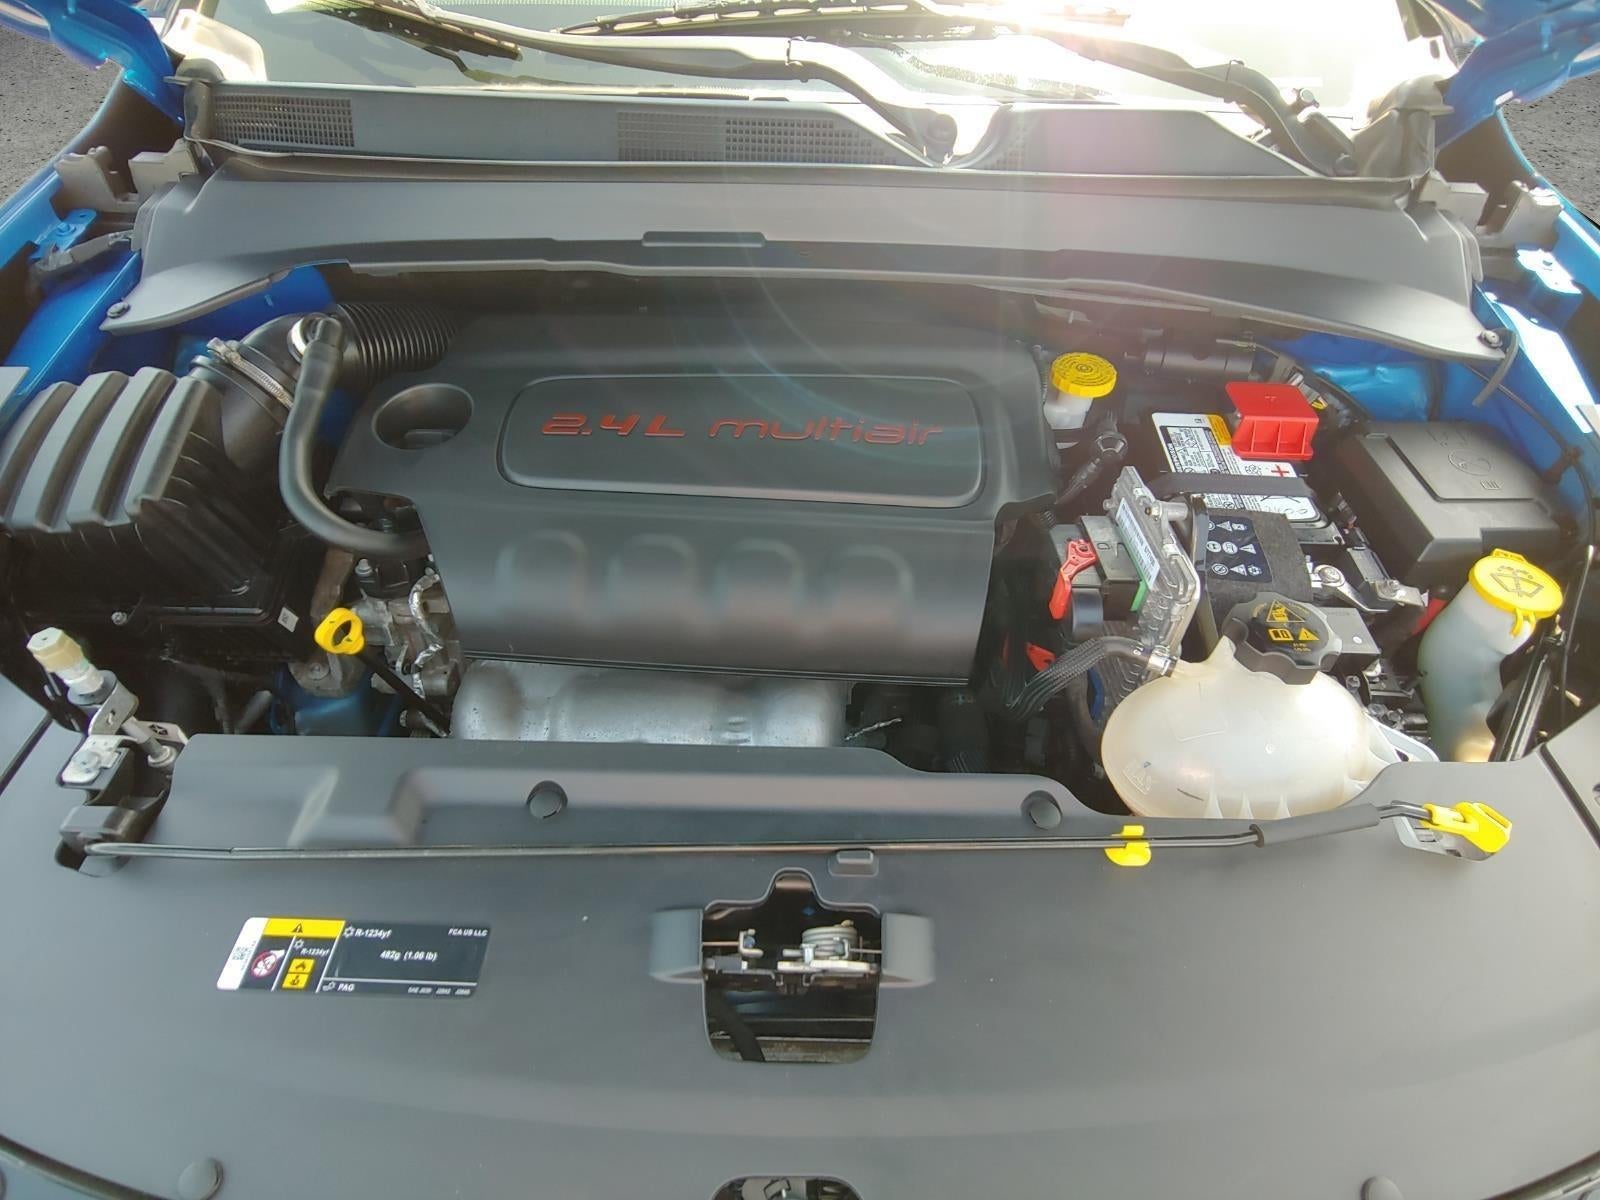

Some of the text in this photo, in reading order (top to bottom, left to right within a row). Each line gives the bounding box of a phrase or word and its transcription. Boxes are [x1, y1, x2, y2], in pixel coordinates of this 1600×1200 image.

[541, 413, 943, 446] 2.4L multiair
[355, 928, 392, 940] R-1234yf
[448, 928, 489, 937] FCA US LLC
[301, 947, 330, 958] R-1234yf
